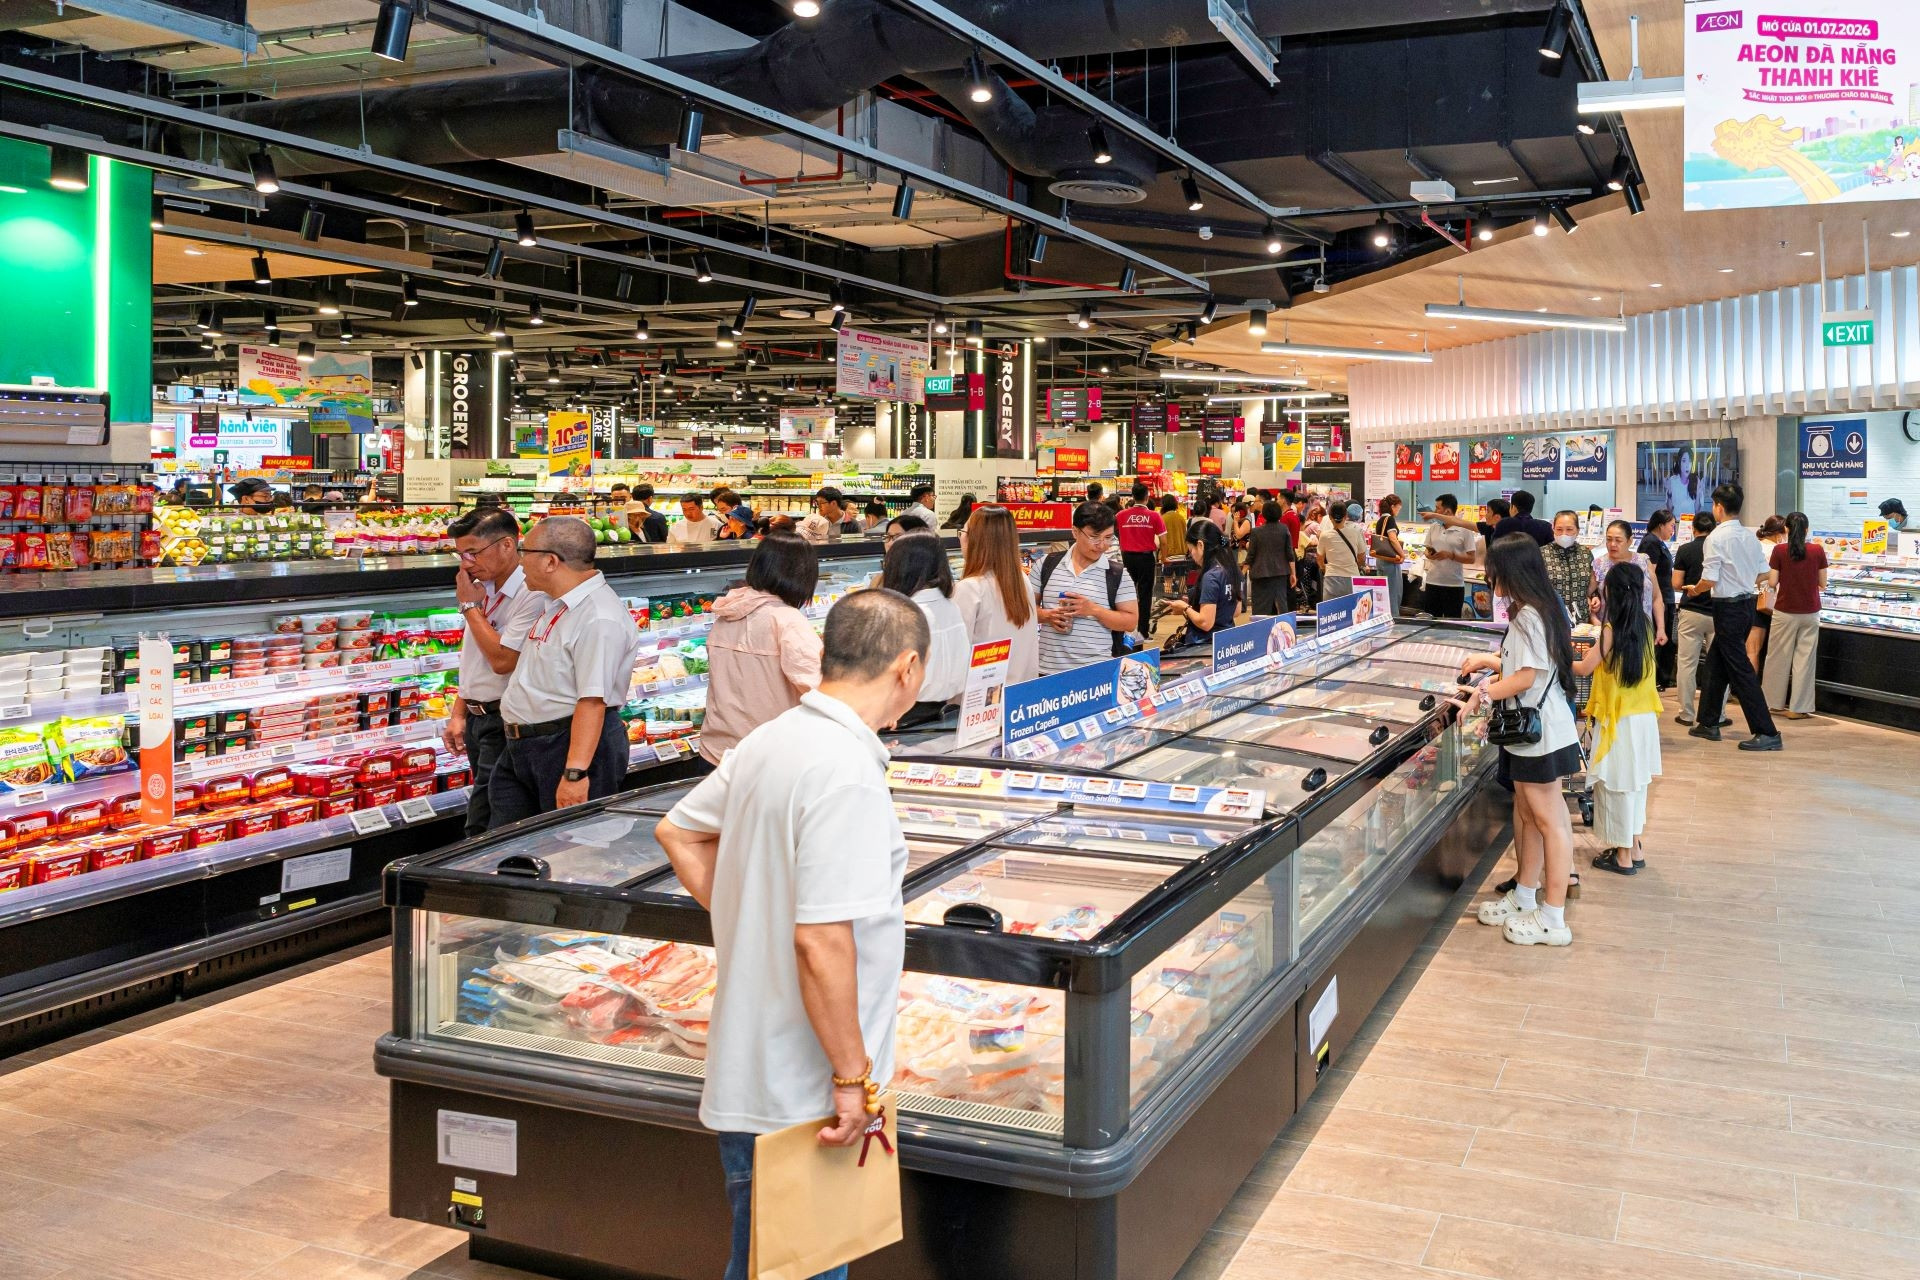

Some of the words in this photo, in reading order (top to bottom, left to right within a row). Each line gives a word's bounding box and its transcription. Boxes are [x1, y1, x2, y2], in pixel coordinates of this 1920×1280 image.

[1803, 22, 1871, 36] 01.07.2026
[1737, 44, 1799, 63] AEON
[1806, 43, 1835, 64] ĐÀ
[1841, 42, 1896, 66] NẴNG
[1758, 67, 1833, 87] THANH
[1840, 65, 1880, 87] KHÊ
[1835, 324, 1870, 343] EXIT
[255, 358, 275, 367] AEON
[262, 365, 285, 375] THANH
[931, 379, 950, 390] EXIT
[970, 387, 984, 397] 1-B
[1001, 342, 1015, 450] GROCERY
[452, 357, 469, 446] GROCERY
[1087, 399, 1102, 408] 2-B
[220, 419, 249, 433] hành
[252, 419, 278, 433] viên
[594, 409, 603, 438] CARE
[602, 410, 612, 443] HOME
[216, 453, 225, 463] 9
[370, 457, 378, 467] 8
[1830, 460, 1844, 469] CÂN
[1846, 459, 1864, 469] HÀNG
[1034, 510, 1054, 522] MẠI
[1216, 648, 1225, 660] CÁ
[1225, 643, 1241, 658] ĐÔNG
[1241, 639, 1254, 655] LẠNH
[1216, 662, 1230, 672] Frozen
[1229, 659, 1238, 667] Fish
[149, 669, 162, 677] KIM
[150, 683, 162, 691] CHI
[183, 684, 200, 695] KIM
[201, 683, 218, 692] CHI
[1010, 707, 1025, 724] CÁ
[1026, 697, 1060, 721] TRỨNG
[1061, 690, 1088, 709] ĐÔNG
[1089, 682, 1113, 702] LẠNH
[1010, 725, 1034, 740] Frozen
[1035, 715, 1060, 731] Capelin
[206, 757, 224, 767] KIM
[224, 754, 241, 764] CHI
[1070, 792, 1095, 802] Frozen
[1095, 794, 1122, 805] Shrimp
